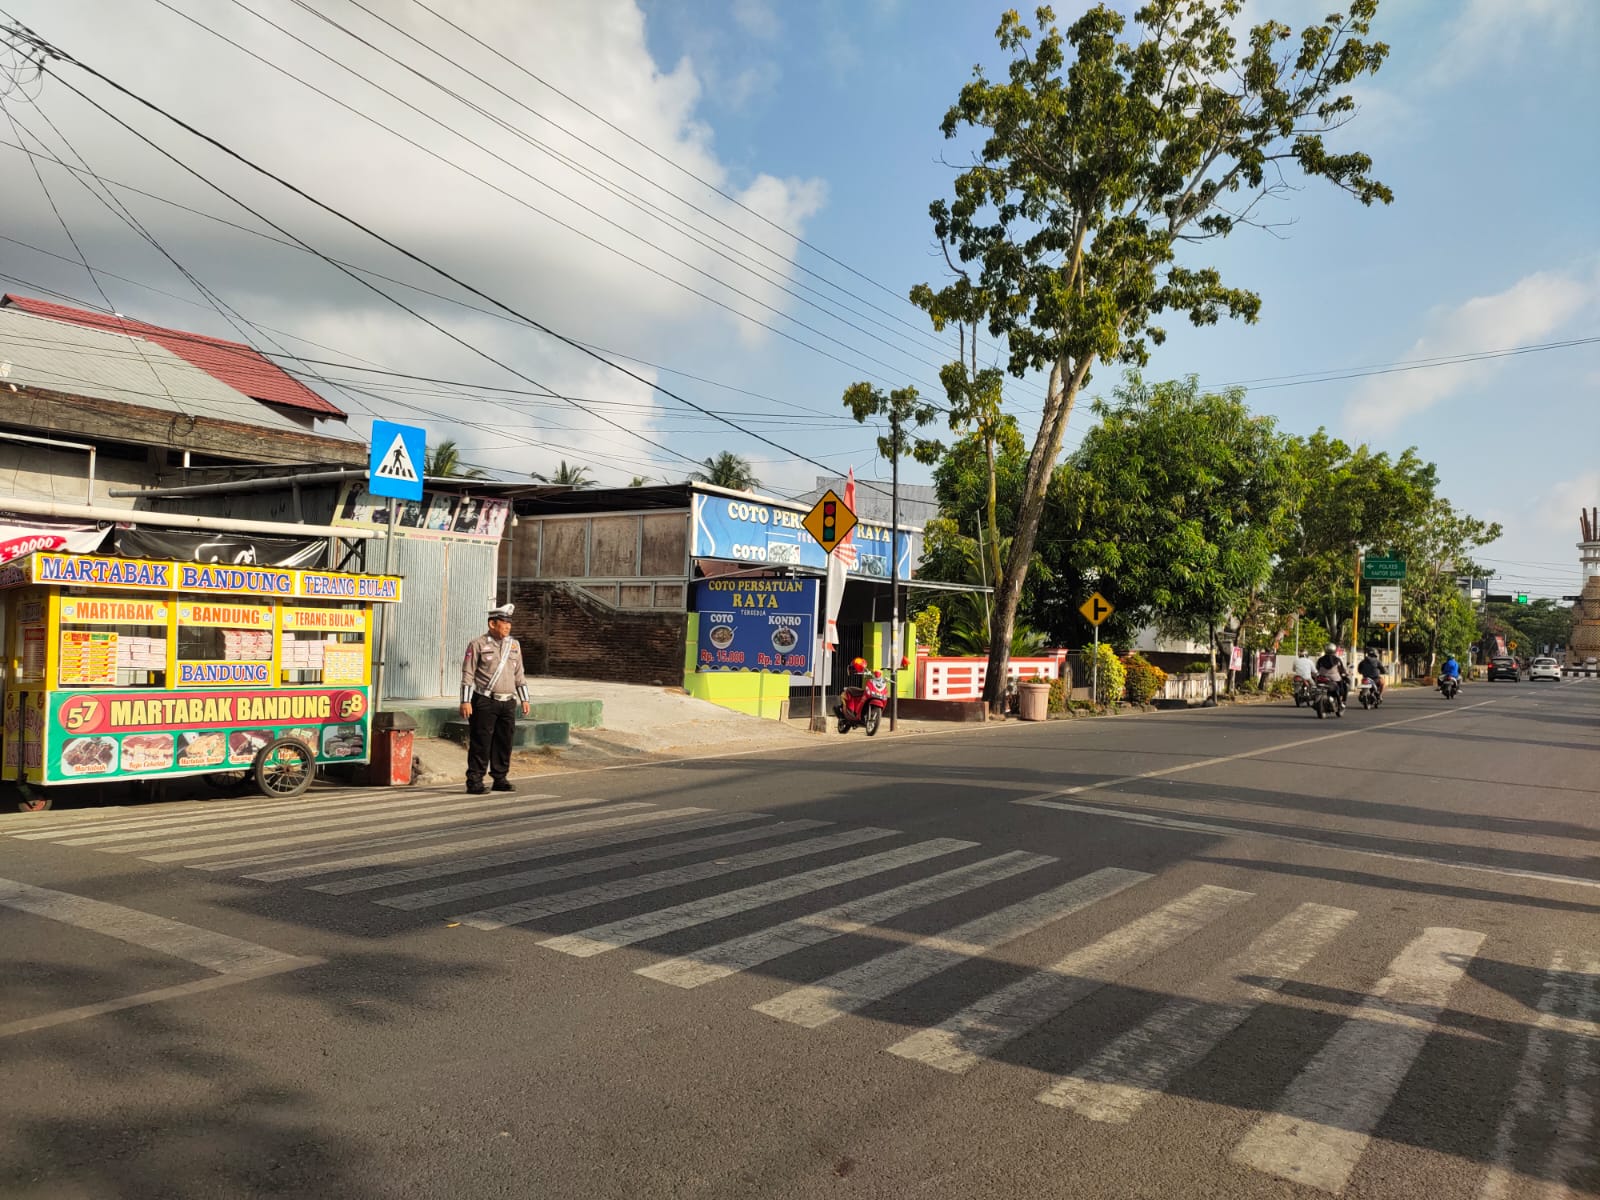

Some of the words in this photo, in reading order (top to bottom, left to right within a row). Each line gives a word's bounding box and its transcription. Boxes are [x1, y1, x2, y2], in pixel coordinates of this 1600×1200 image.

[727, 502, 769, 524] COTO
[856, 524, 891, 543] RAYA
[732, 543, 767, 561] COTO
[41, 557, 170, 587] MARTABAK
[181, 565, 292, 593] BANDUNG
[303, 575, 355, 597] TERANG
[358, 578, 398, 599] BULAN
[708, 581, 736, 591] COTO
[738, 581, 803, 592] PERSATUAN
[732, 593, 779, 609] RAYA
[75, 601, 155, 620] MARTABAK
[192, 605, 261, 626] BANDUNG
[294, 611, 328, 628] TERANG
[328, 612, 356, 628] BULAN
[710, 613, 734, 624] COTO
[768, 615, 802, 626] KONRO
[701, 649, 715, 663] Rp.
[758, 652, 773, 667] Rp.
[179, 663, 269, 682] BANDUNG
[66, 701, 99, 730] 57
[110, 699, 234, 727] MARTABAK
[236, 694, 331, 722] BANDUNG
[339, 693, 363, 718] 58
